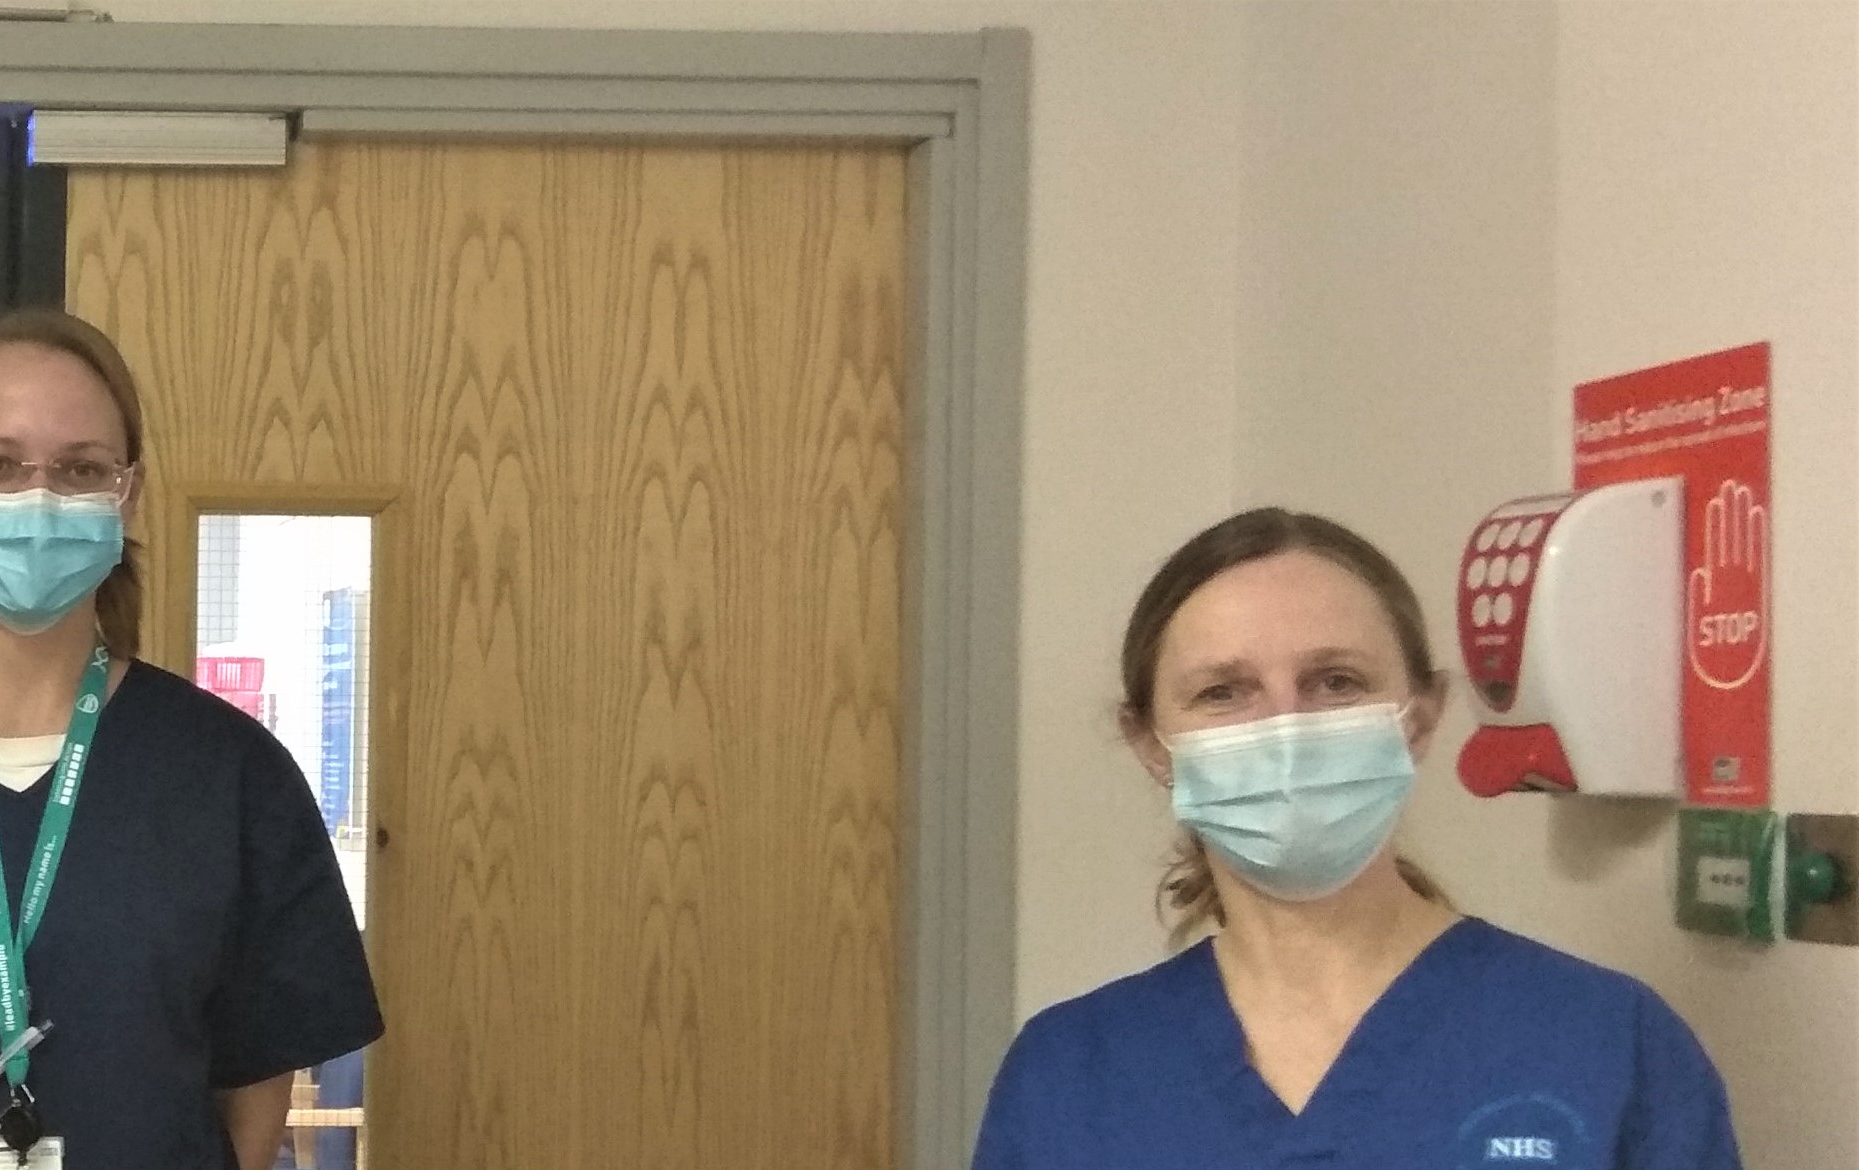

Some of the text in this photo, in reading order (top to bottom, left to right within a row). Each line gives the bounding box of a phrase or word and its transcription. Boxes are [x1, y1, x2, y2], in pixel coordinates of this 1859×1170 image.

[1574, 385, 1767, 442] Hand Sanitising Zone
[1698, 610, 1758, 646] STOP
[38, 851, 52, 880] name
[33, 880, 45, 896] my
[23, 897, 38, 924] Hello
[1489, 1137, 1554, 1160] NHS
